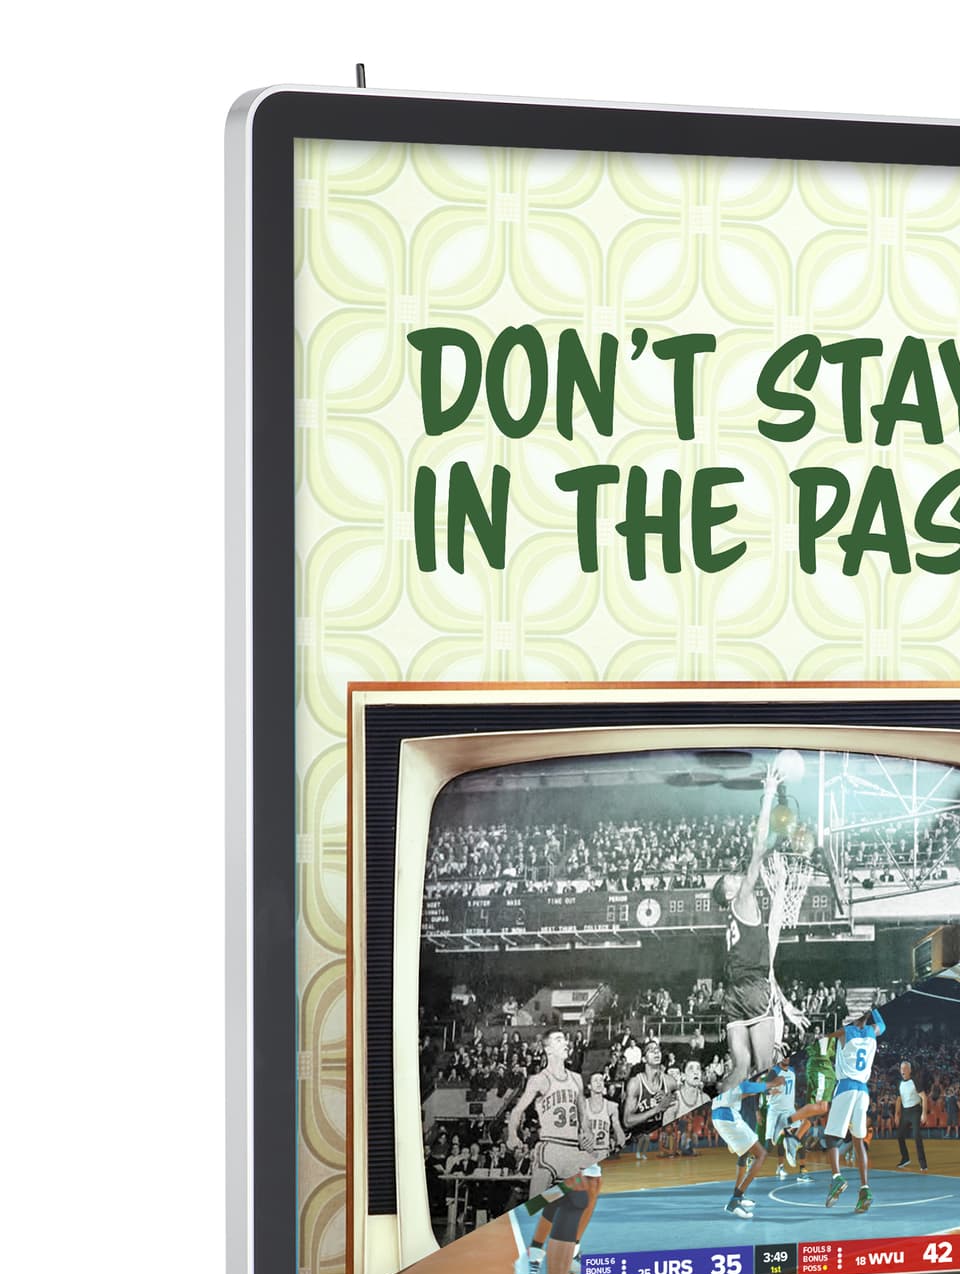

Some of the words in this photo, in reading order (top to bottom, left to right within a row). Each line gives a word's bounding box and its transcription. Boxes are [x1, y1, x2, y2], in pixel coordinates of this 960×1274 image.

[406, 324, 716, 441] DON'T
[414, 461, 511, 574] IN
[555, 464, 747, 581] THE
[856, 1048, 866, 1071] 6
[803, 1246, 825, 1254] FOULS
[826, 1245, 831, 1253] 8
[855, 1256, 866, 1265] 18
[923, 1242, 953, 1263] 42
[586, 1258, 609, 1266] FOULS
[610, 1257, 616, 1265] 6
[763, 1251, 788, 1262] 3:49
[803, 1255, 828, 1263] BONUS
[586, 1267, 611, 1274] BONUS
[803, 1264, 821, 1272] POSS
